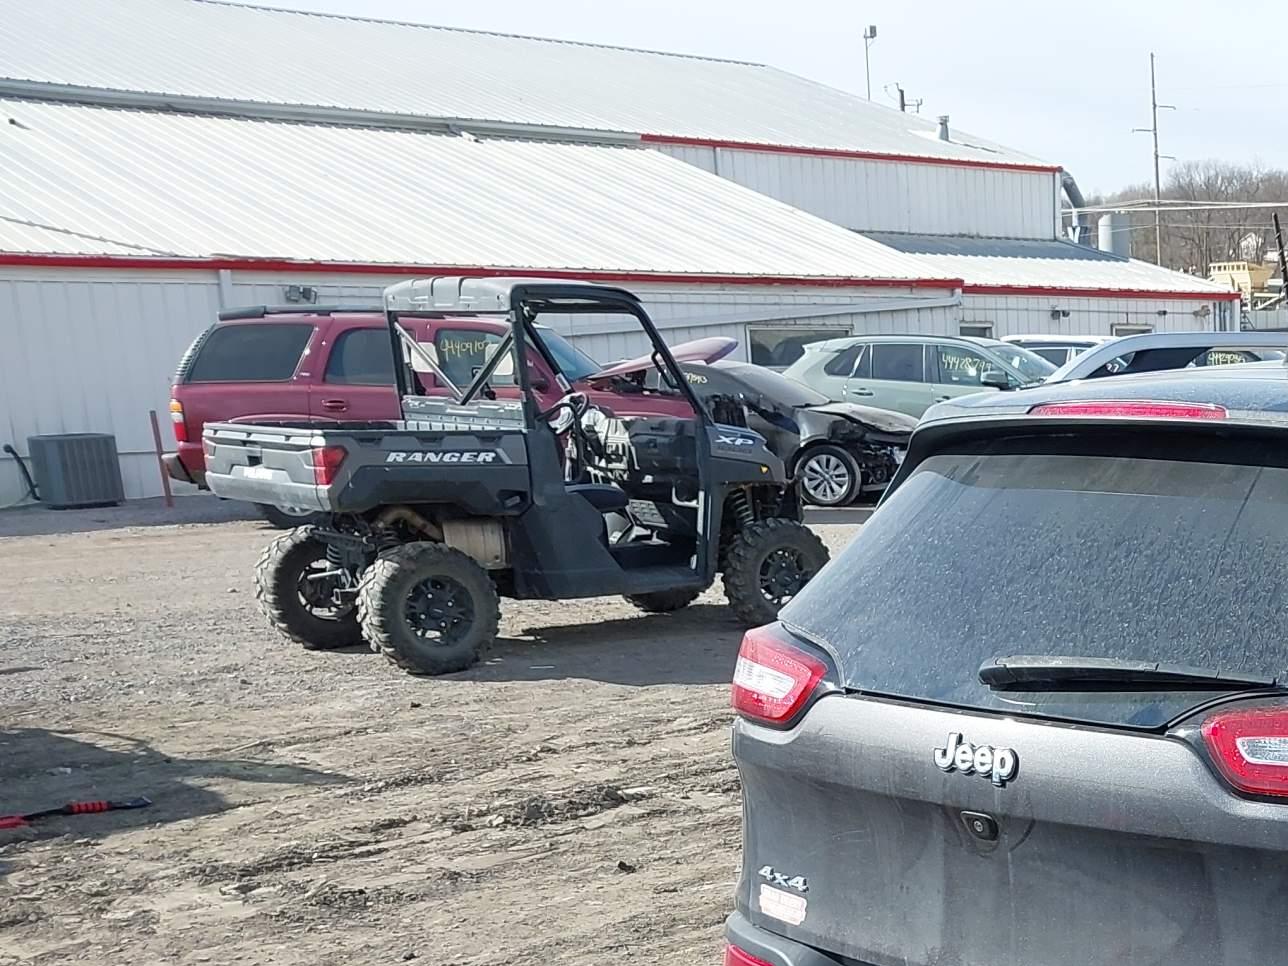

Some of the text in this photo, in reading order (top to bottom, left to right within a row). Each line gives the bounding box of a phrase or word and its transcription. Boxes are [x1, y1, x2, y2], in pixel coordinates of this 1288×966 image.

[714, 435, 755, 446] XP
[386, 451, 497, 464] RANGER
[933, 732, 1020, 789] Jeep
